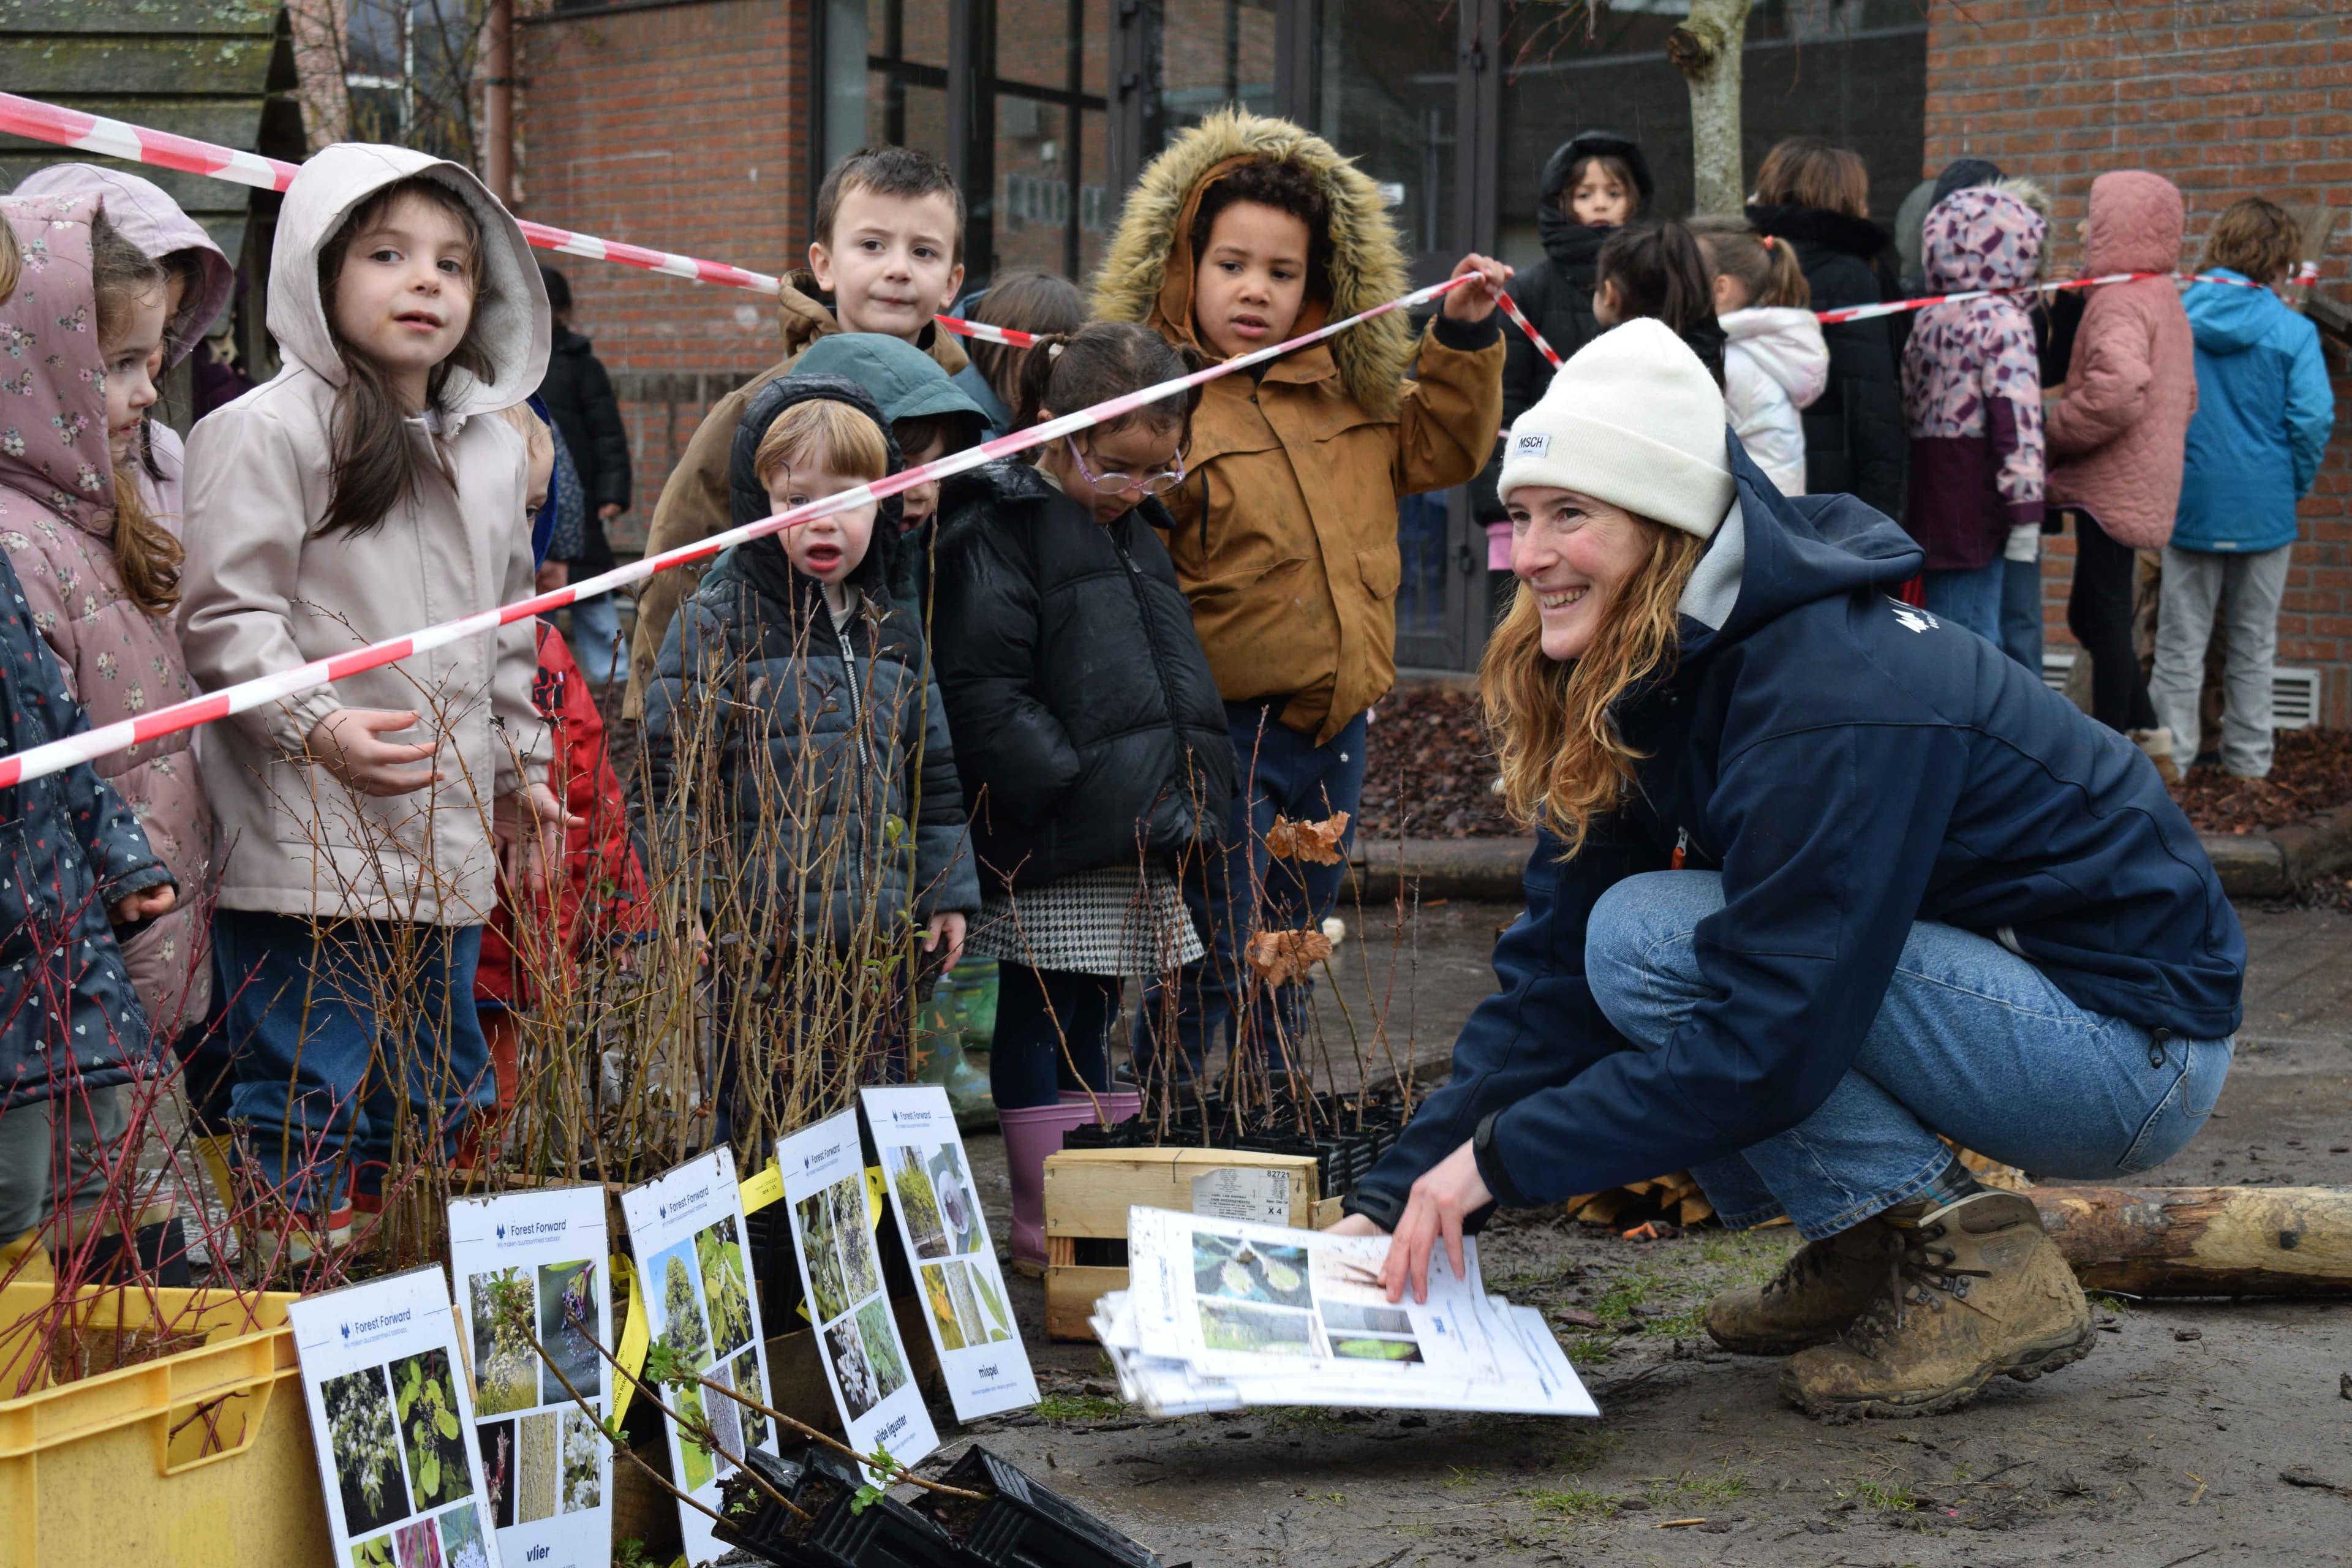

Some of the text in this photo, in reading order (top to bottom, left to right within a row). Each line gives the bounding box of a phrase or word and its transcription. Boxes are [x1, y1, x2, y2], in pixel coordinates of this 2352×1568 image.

[1519, 436, 1544, 448] MSCH
[900, 1110, 932, 1120] Forest Forward
[811, 1142, 840, 1165] Forest Forward
[1267, 1170, 1289, 1178] 82721
[669, 1185, 709, 1213] Forest Forward
[511, 1218, 567, 1236] Forest Forward
[355, 1308, 411, 1334] Forest Forward
[620, 1363, 633, 1392] BERCEM
[979, 1363, 999, 1380] mispel
[873, 1428, 889, 1444] wilde
[886, 1414, 907, 1438] liguster
[527, 1544, 550, 1562] vlier
